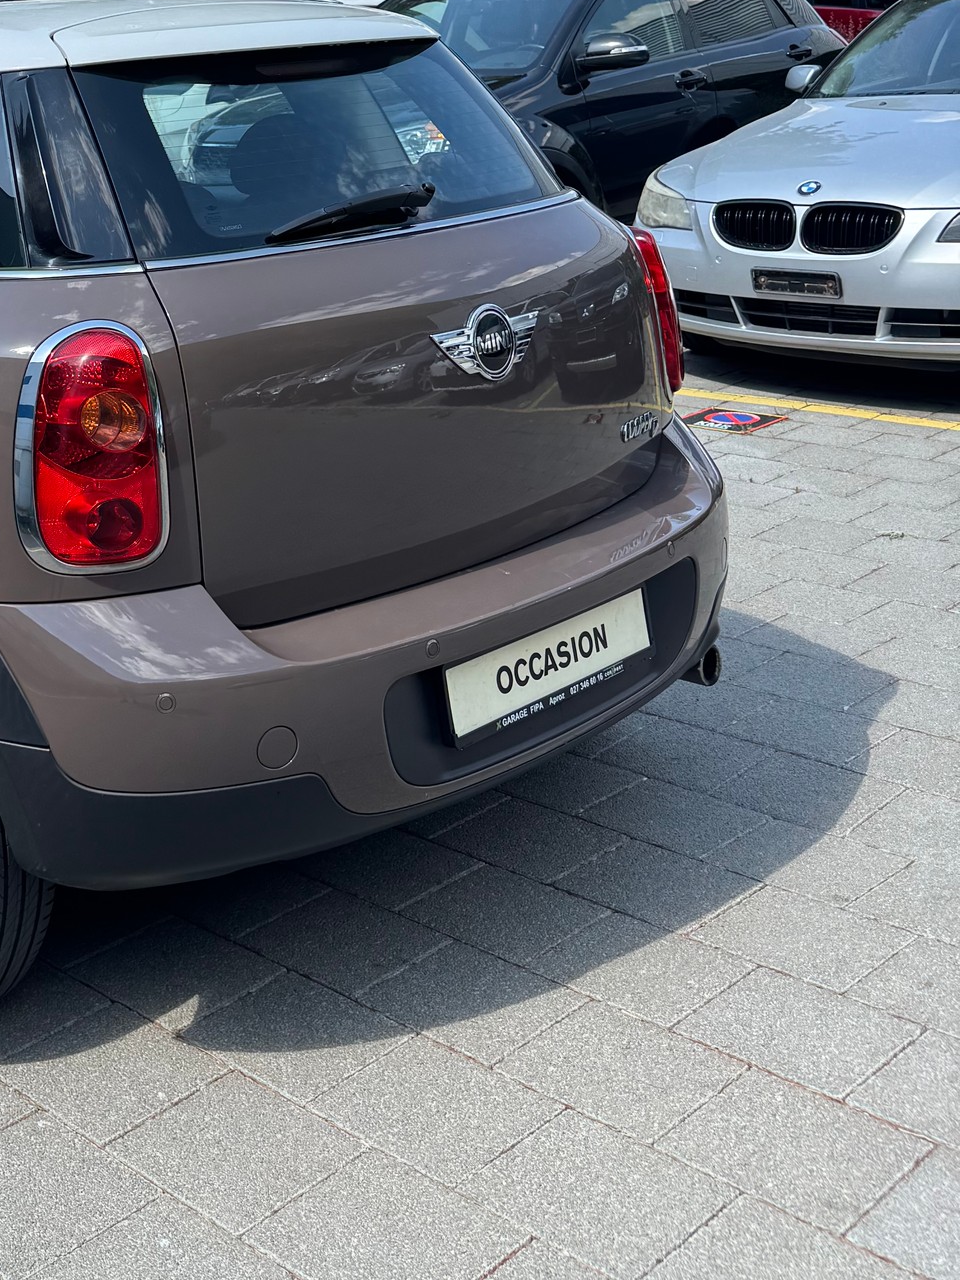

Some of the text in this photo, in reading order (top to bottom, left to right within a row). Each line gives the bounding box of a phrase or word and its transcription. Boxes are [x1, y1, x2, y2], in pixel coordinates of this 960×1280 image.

[477, 329, 511, 354] MINI
[496, 623, 608, 694] OCCASION
[502, 708, 528, 727] GARAGE
[530, 701, 544, 715] FIPA
[549, 692, 566, 706] Aproz
[569, 683, 579, 695] 027
[580, 679, 590, 690] 346
[597, 672, 604, 682] 16
